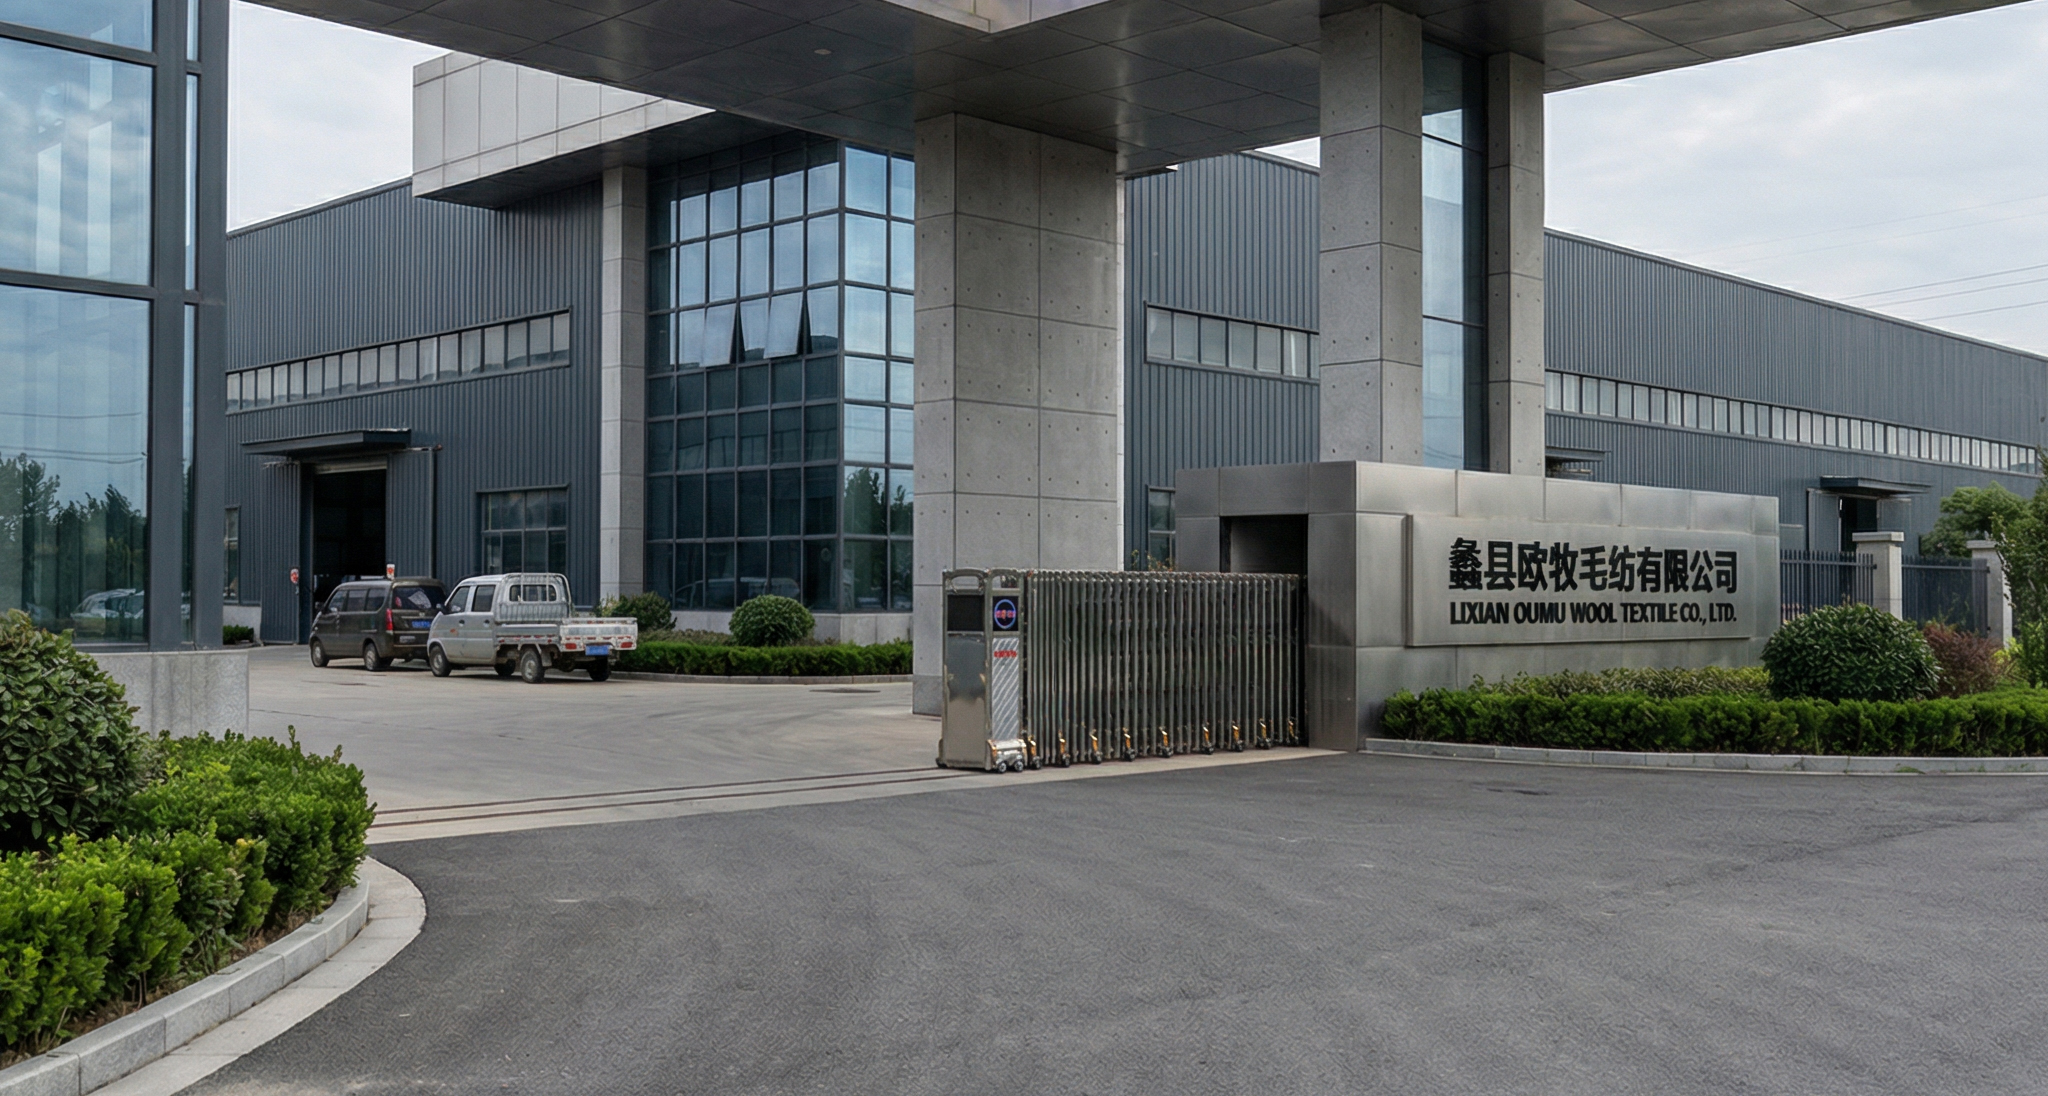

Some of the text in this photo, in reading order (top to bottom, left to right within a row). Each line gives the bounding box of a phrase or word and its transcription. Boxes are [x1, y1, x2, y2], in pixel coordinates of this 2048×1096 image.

[1449, 537, 1738, 594] 蠡县欧牧毛纺有限公司
[1450, 601, 1737, 626] LIXIAN OUMU WOOL TEXTILE CO., LTD.
